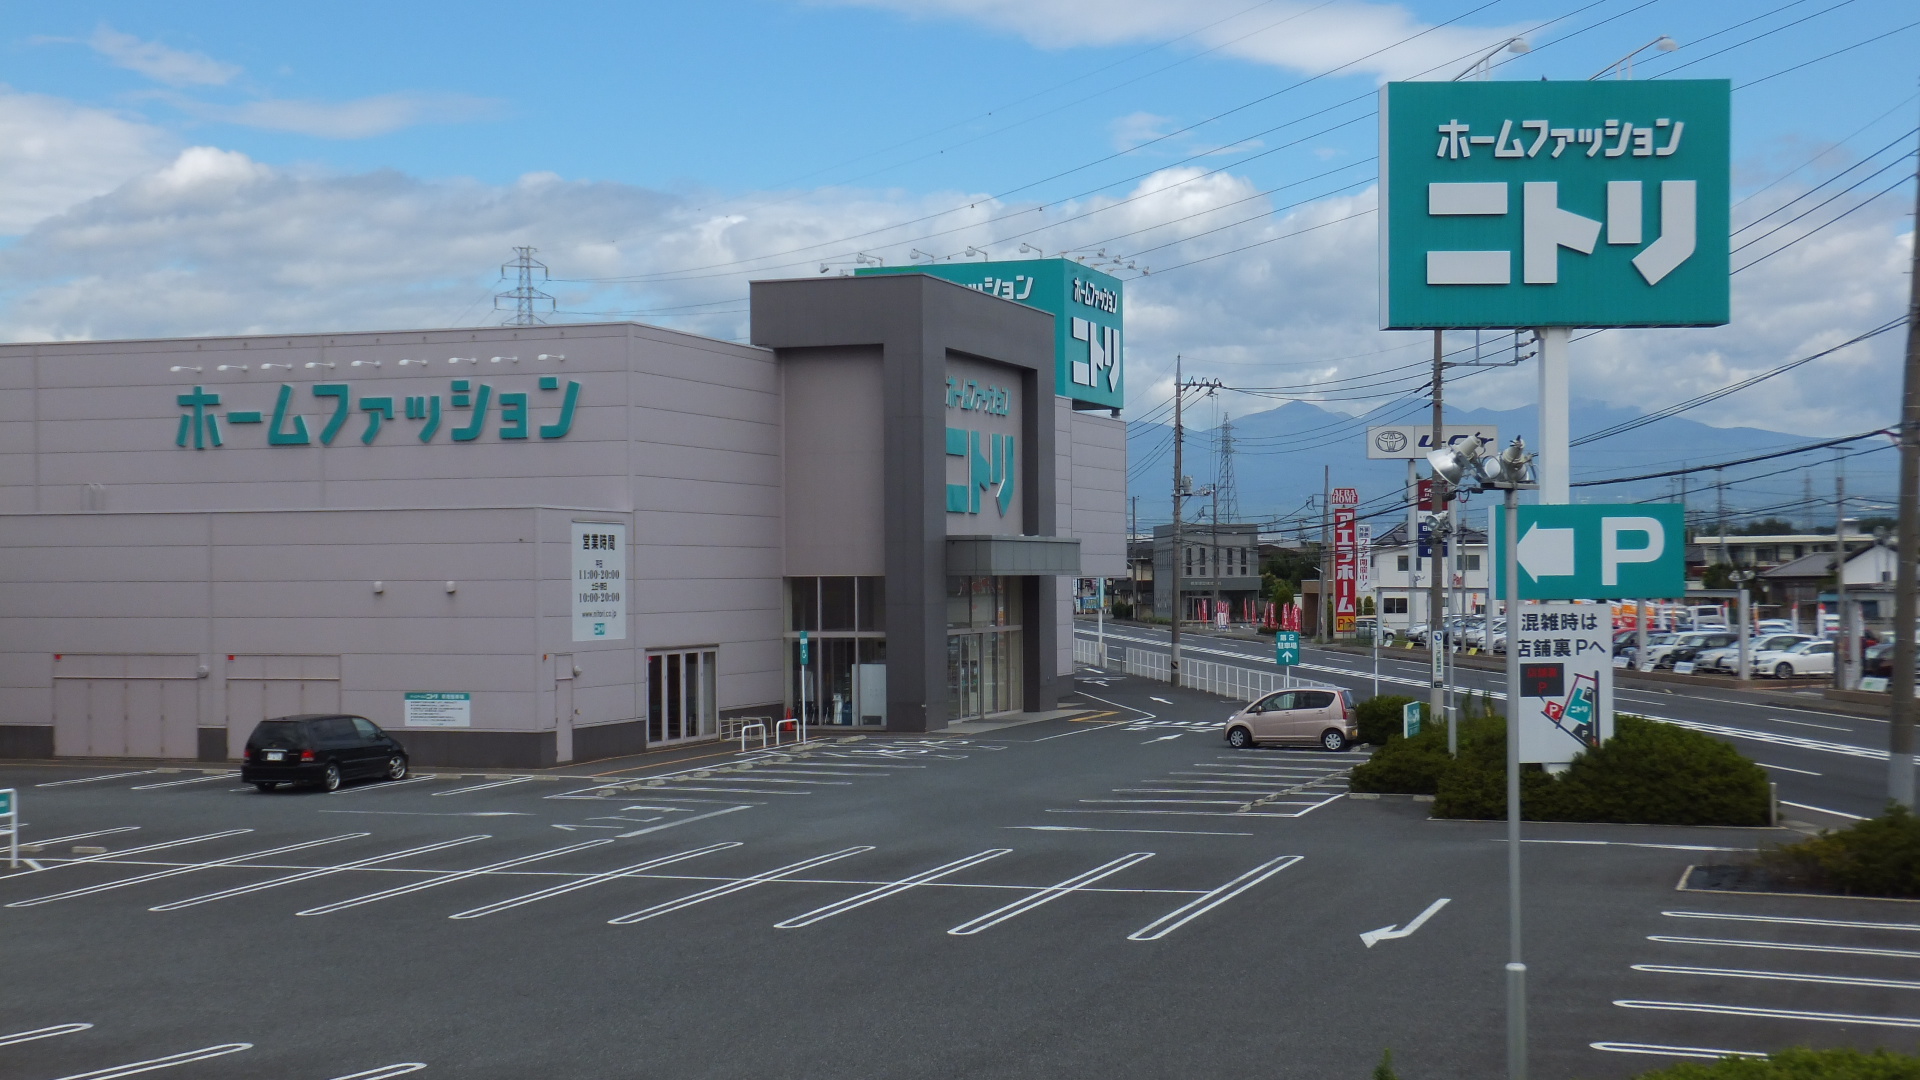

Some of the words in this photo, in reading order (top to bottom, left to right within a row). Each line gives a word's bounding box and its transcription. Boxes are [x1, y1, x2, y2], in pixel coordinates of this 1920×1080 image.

[1437, 118, 1684, 159] ホームファッション
[1426, 180, 1697, 286] ニトリ
[1074, 277, 1118, 314] ホームファッション
[1072, 316, 1120, 393] ニトリ
[946, 376, 1011, 416] ホームファッション
[176, 376, 581, 450] ホームファッション
[946, 427, 1014, 518] ニトリ
[582, 533, 616, 551] 営業時間
[1602, 517, 1665, 585] P
[579, 569, 620, 580] 11:00-20:00
[1336, 512, 1355, 612] アエラホーム
[579, 592, 620, 603] 10:00-20:00
[1338, 618, 1346, 629] P
[1521, 612, 1598, 632] 混雑時は
[1517, 639, 1606, 658] 店舗裏Pへ
[1538, 681, 1548, 694] P
[1550, 704, 1559, 716] P
[1570, 705, 1589, 714] ニトリ
